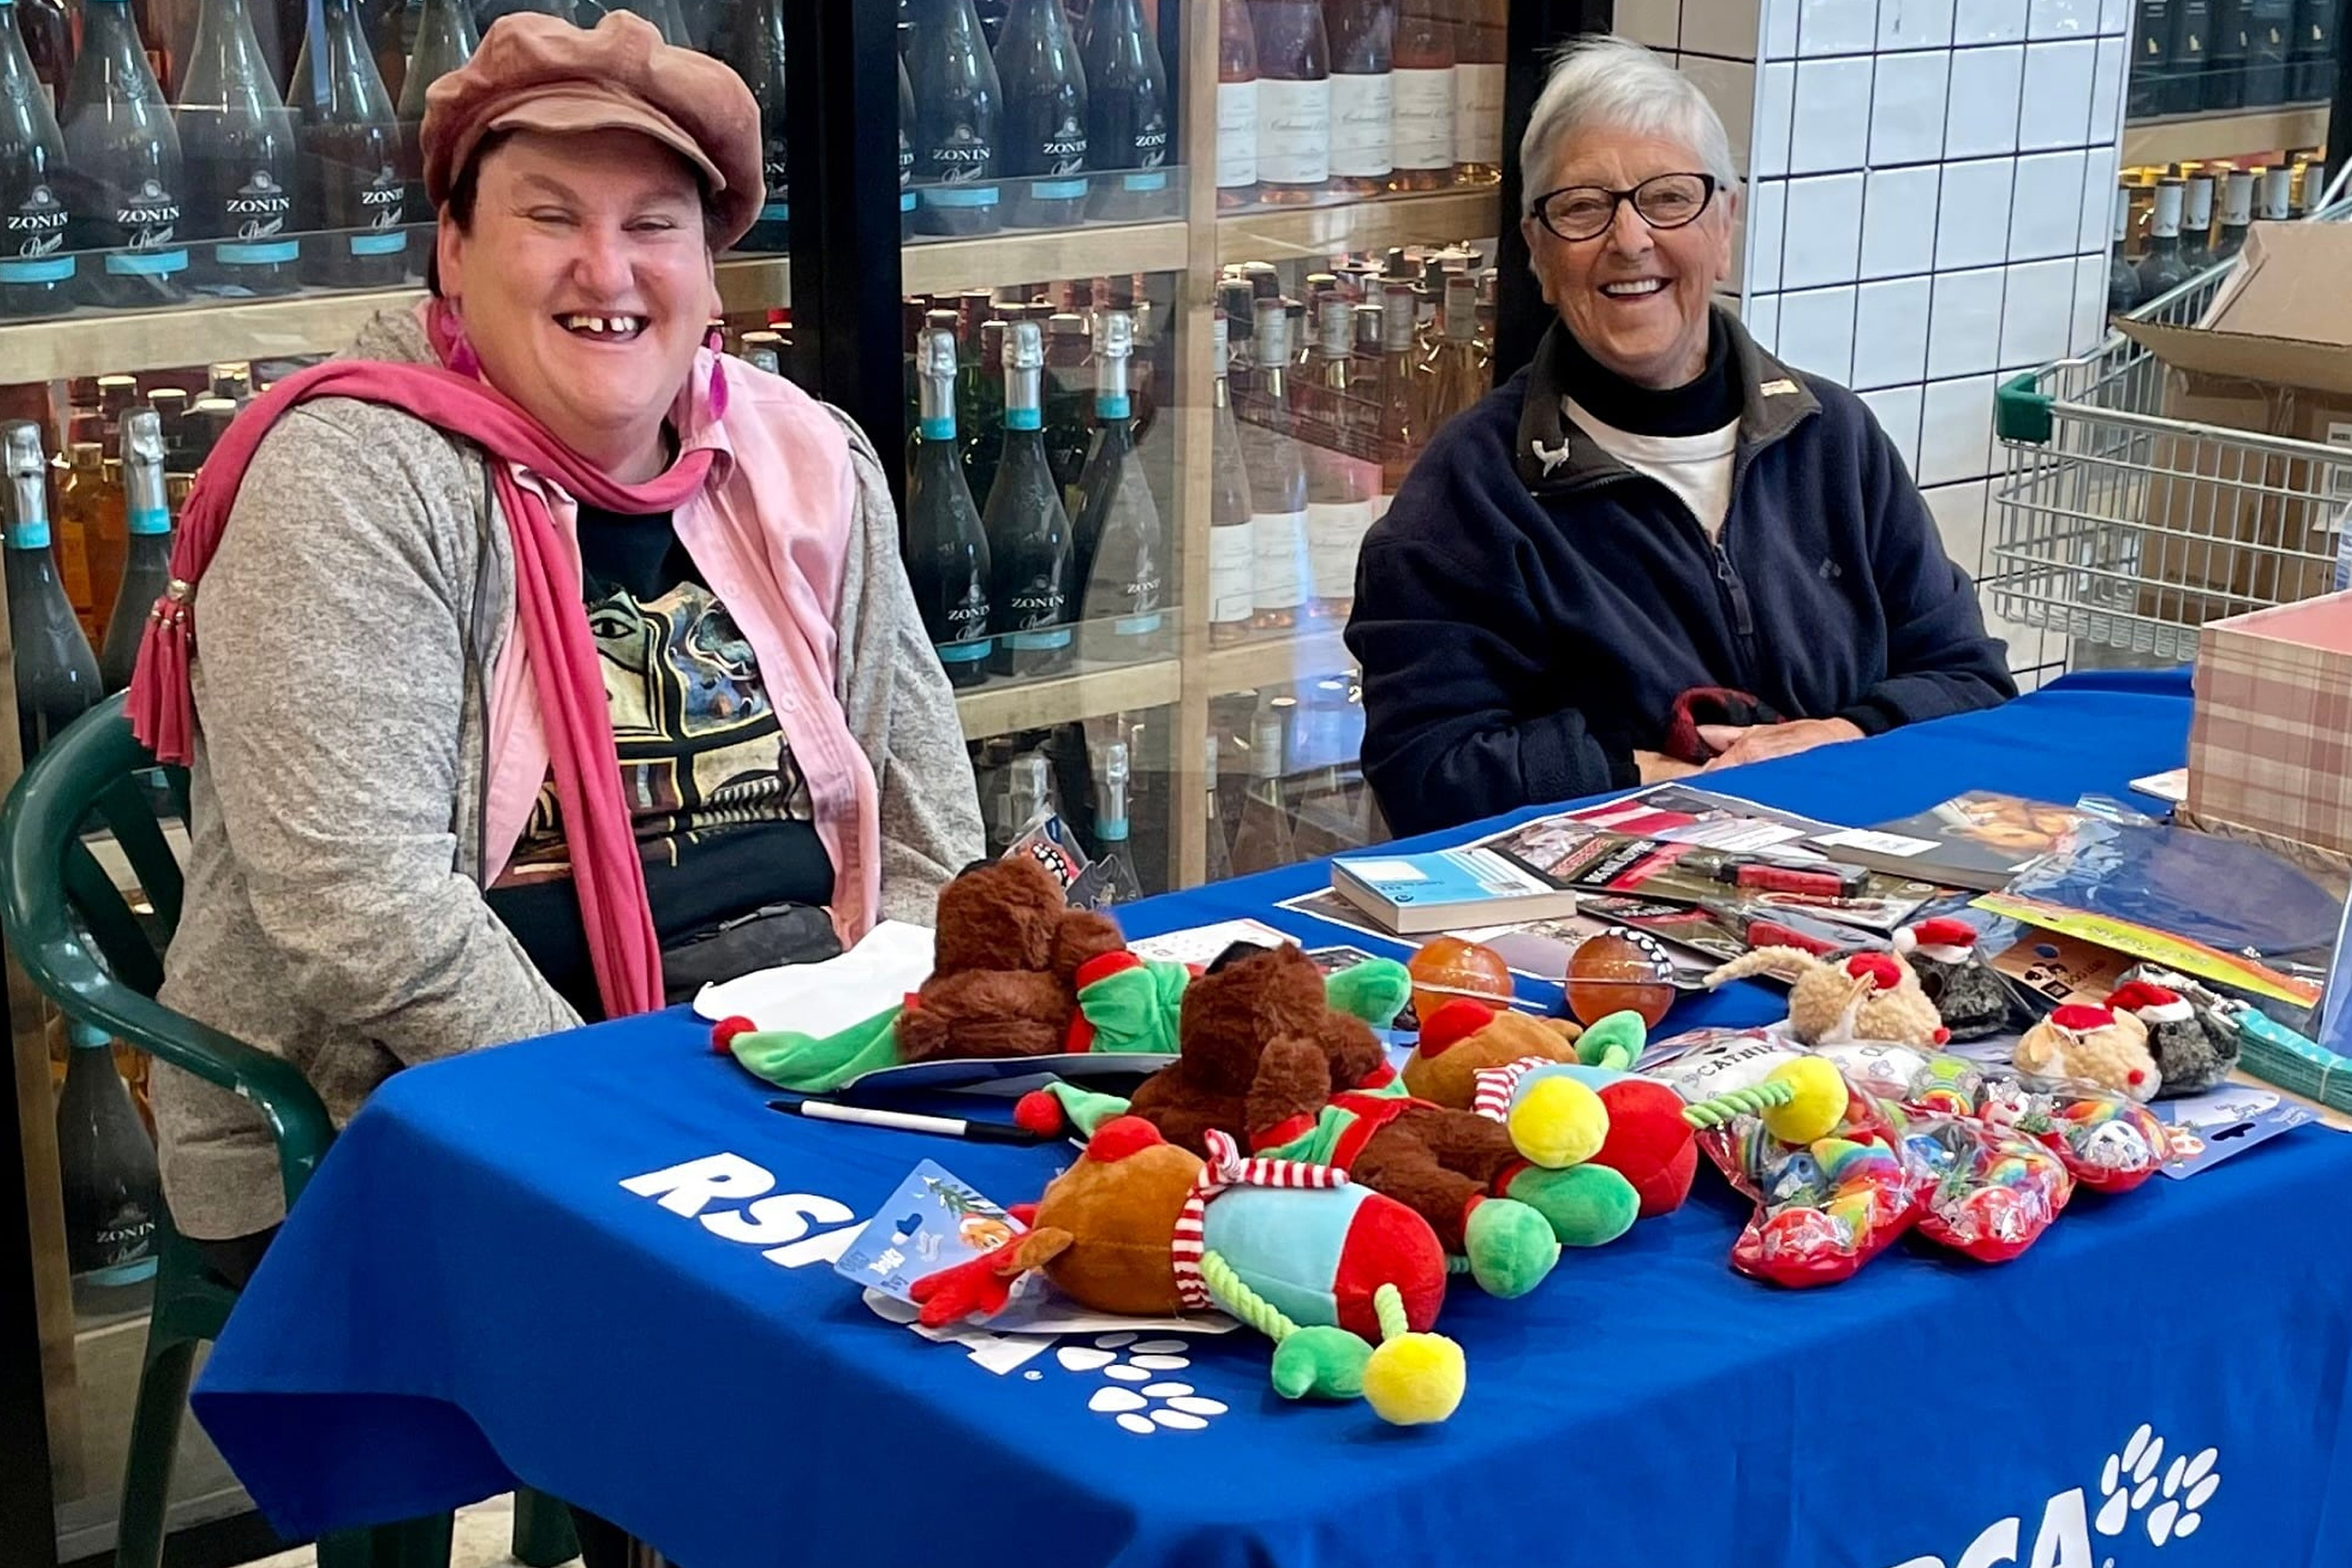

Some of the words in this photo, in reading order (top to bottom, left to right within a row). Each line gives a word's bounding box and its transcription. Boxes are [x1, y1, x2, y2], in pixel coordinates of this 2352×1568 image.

[933, 147, 990, 161] ZONIN
[227, 197, 290, 212] ZONIN
[7, 211, 69, 230] ZONIN
[117, 205, 180, 223] ZONIN
[1012, 594, 1065, 608] ZONIN
[96, 1221, 155, 1243] ZONIN
